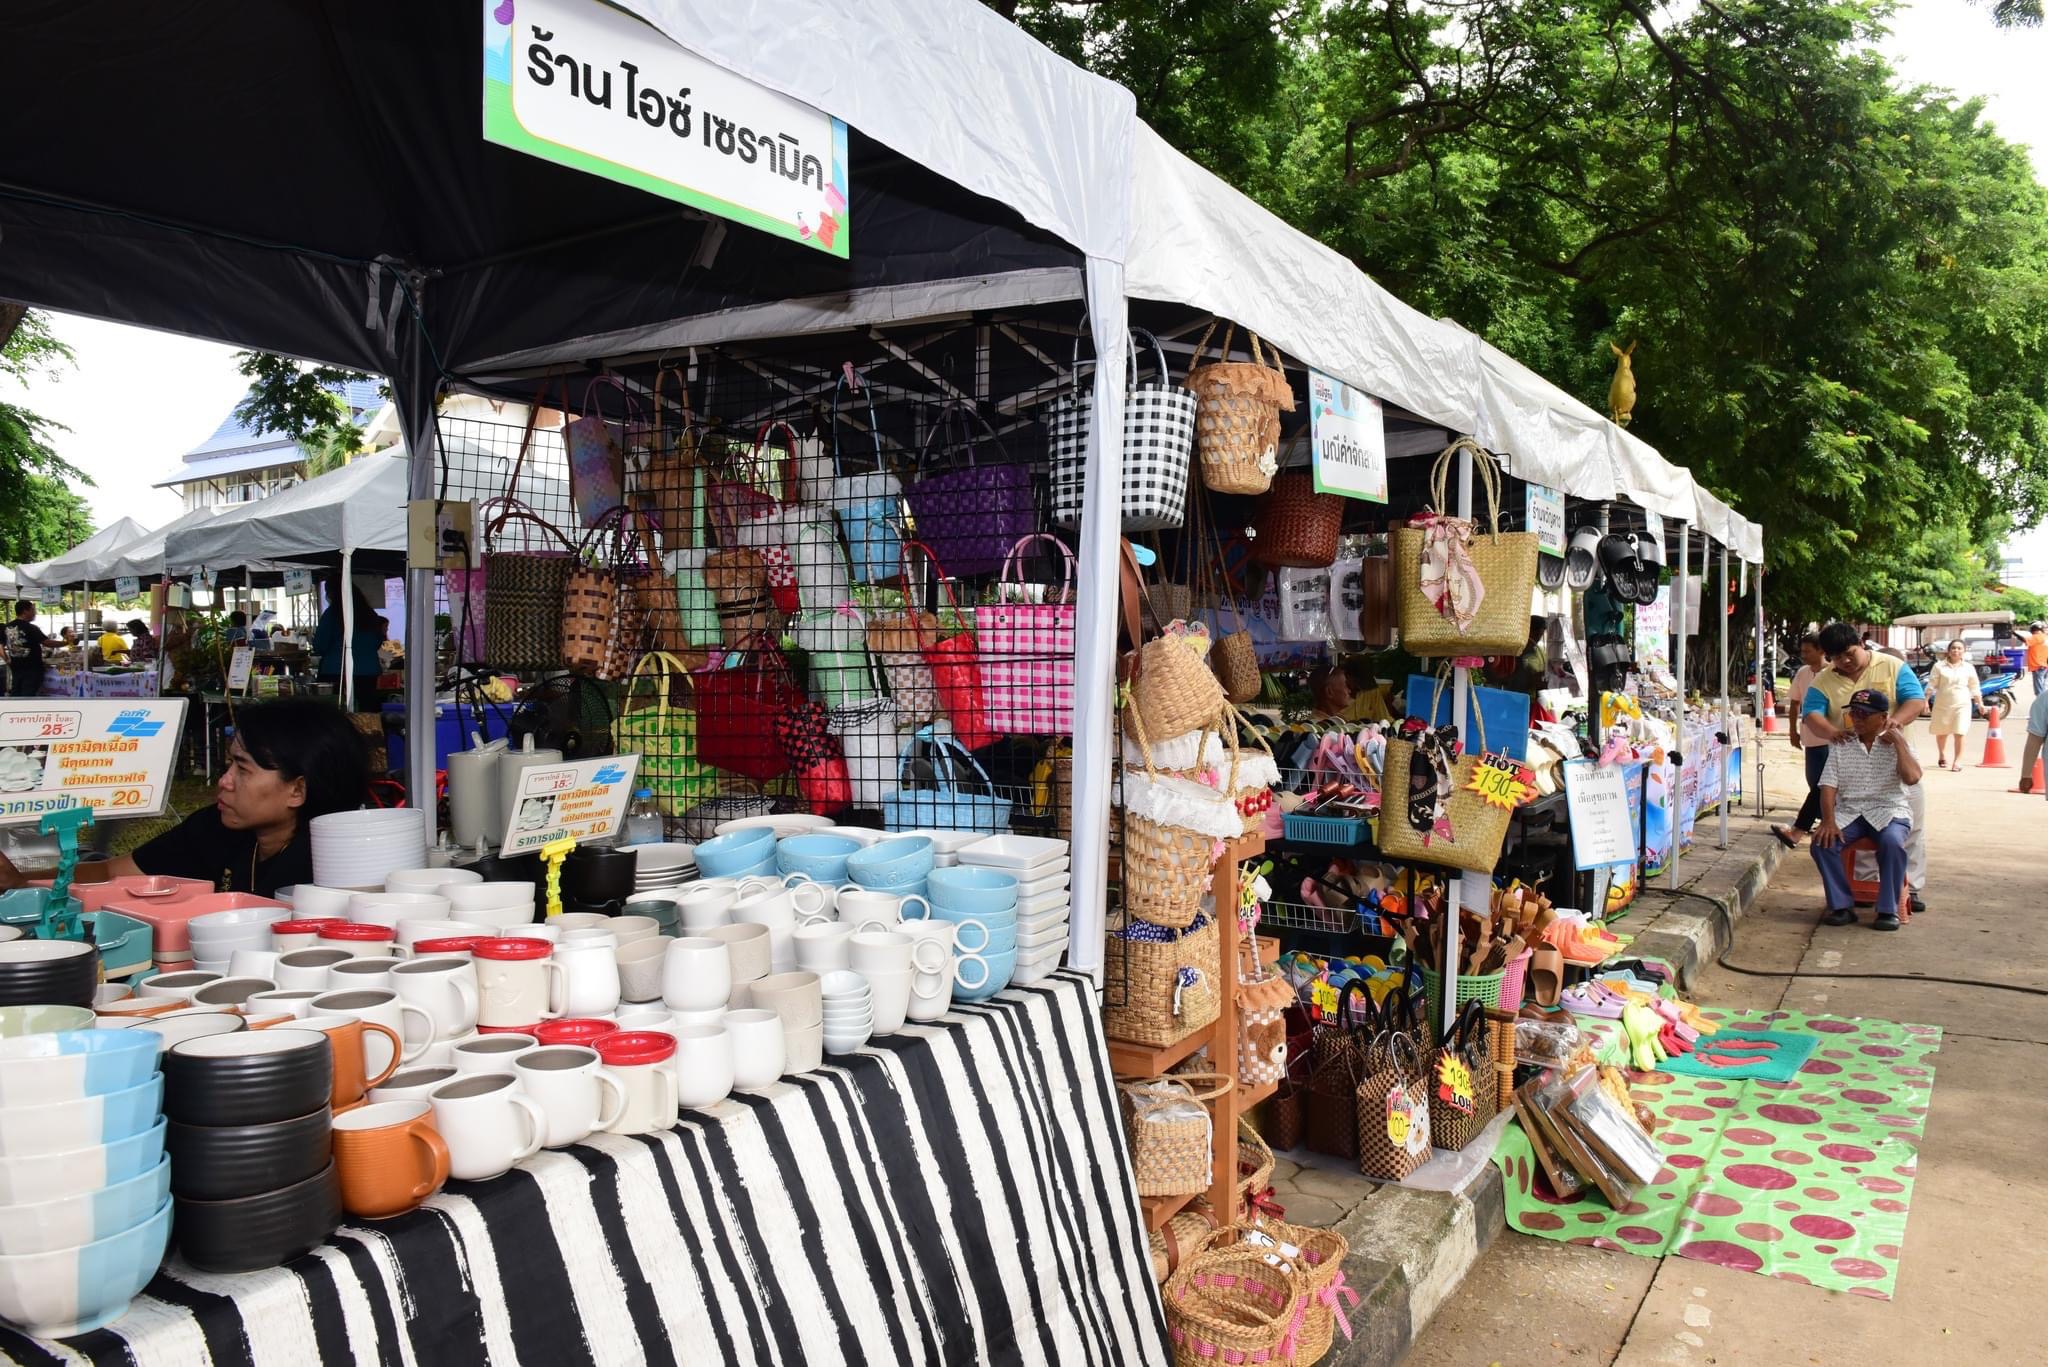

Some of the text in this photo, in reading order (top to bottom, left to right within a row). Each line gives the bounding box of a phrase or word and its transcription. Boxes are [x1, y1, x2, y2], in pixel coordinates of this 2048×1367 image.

[527, 24, 824, 191] ร้าน ไอซ์ เซรามิค
[9, 713, 52, 724] ราคาปกติ
[41, 723, 74, 736] 25.-
[60, 757, 113, 772] มีคุณภาพ
[1483, 754, 1521, 775] HOT
